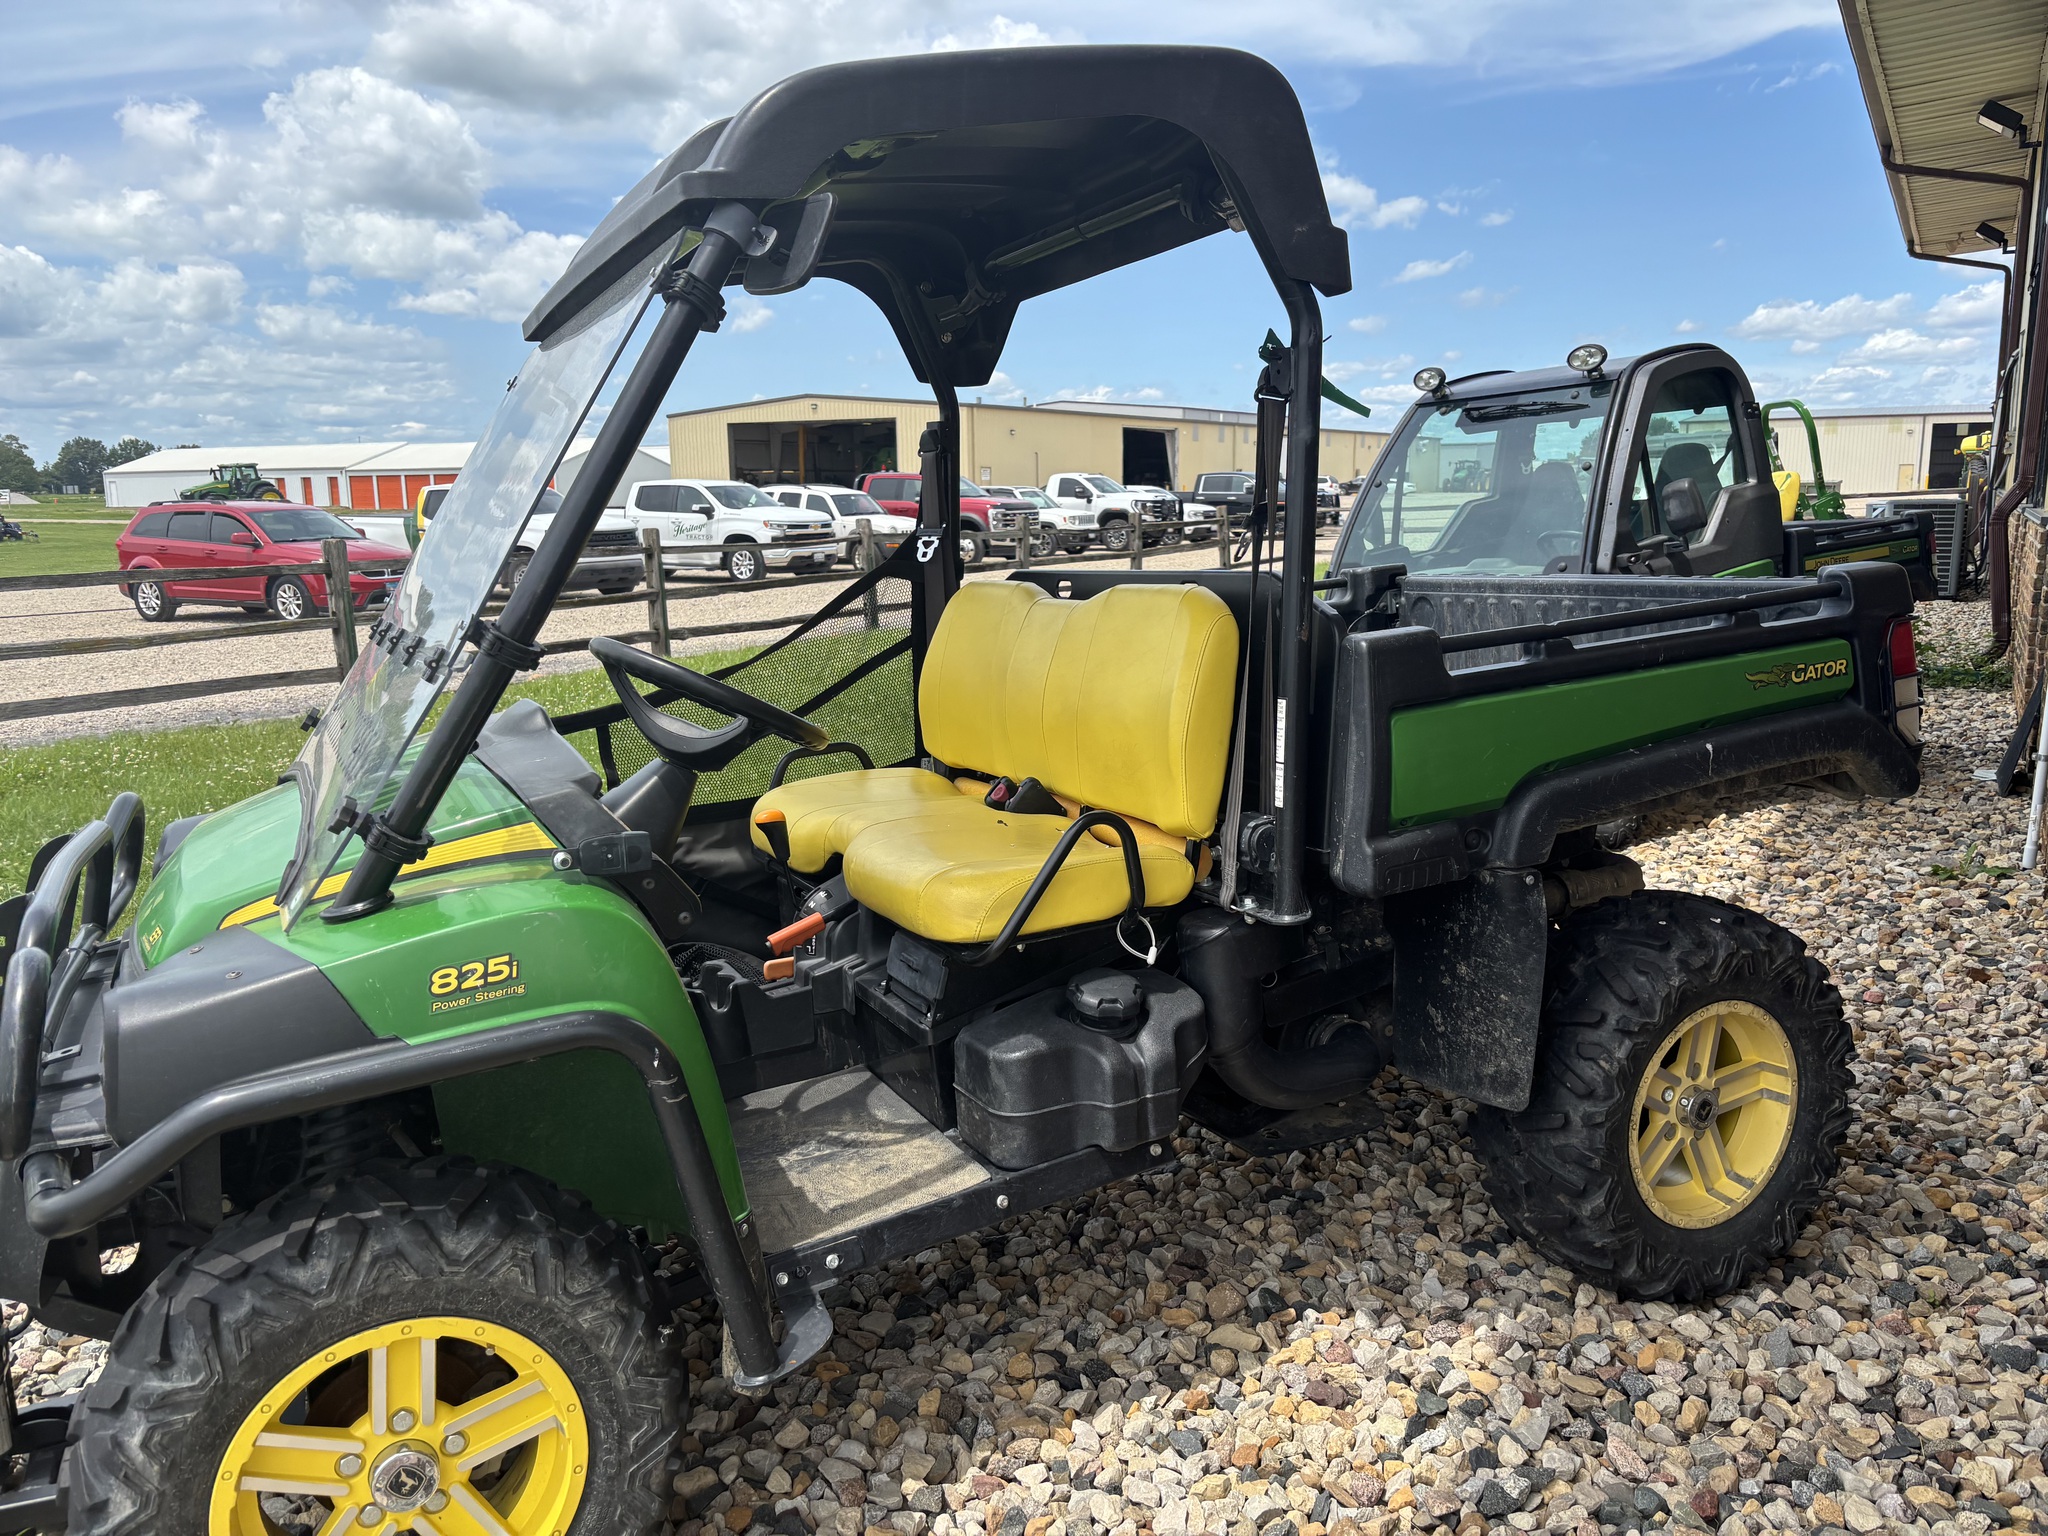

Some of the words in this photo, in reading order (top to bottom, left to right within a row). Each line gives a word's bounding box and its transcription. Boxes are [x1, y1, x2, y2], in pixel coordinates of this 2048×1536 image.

[673, 522, 707, 537] Heritage
[1902, 545, 1918, 553] GATOR
[1791, 659, 1847, 683] GATOR
[430, 954, 518, 995] 825i
[432, 997, 471, 1012] Power
[475, 984, 525, 1002] Steering
